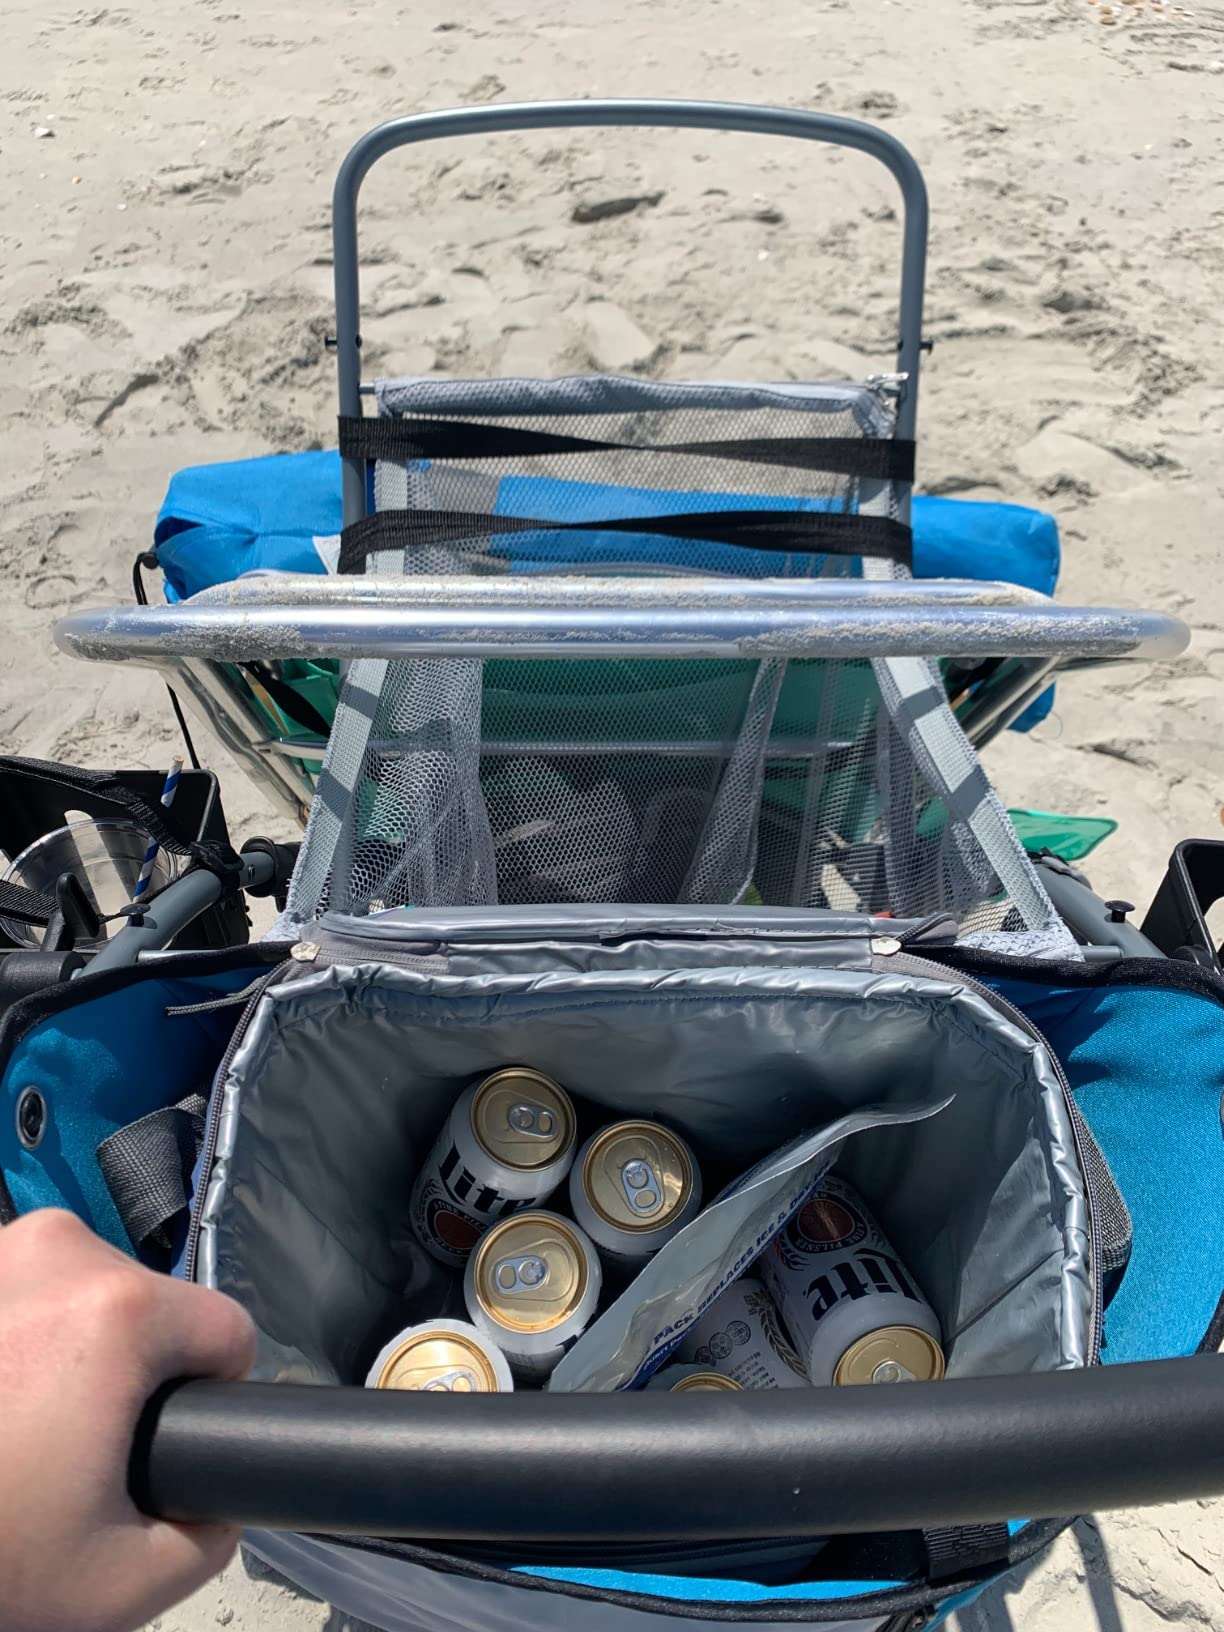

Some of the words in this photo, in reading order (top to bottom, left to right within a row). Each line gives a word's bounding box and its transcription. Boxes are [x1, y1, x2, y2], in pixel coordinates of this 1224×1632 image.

[794, 1237, 843, 1252] PILSNER
[654, 1312, 695, 1346] PACK
[697, 1246, 755, 1315] REPLACES
[756, 1222, 775, 1248] ICE
[802, 1247, 924, 1321] Lite
